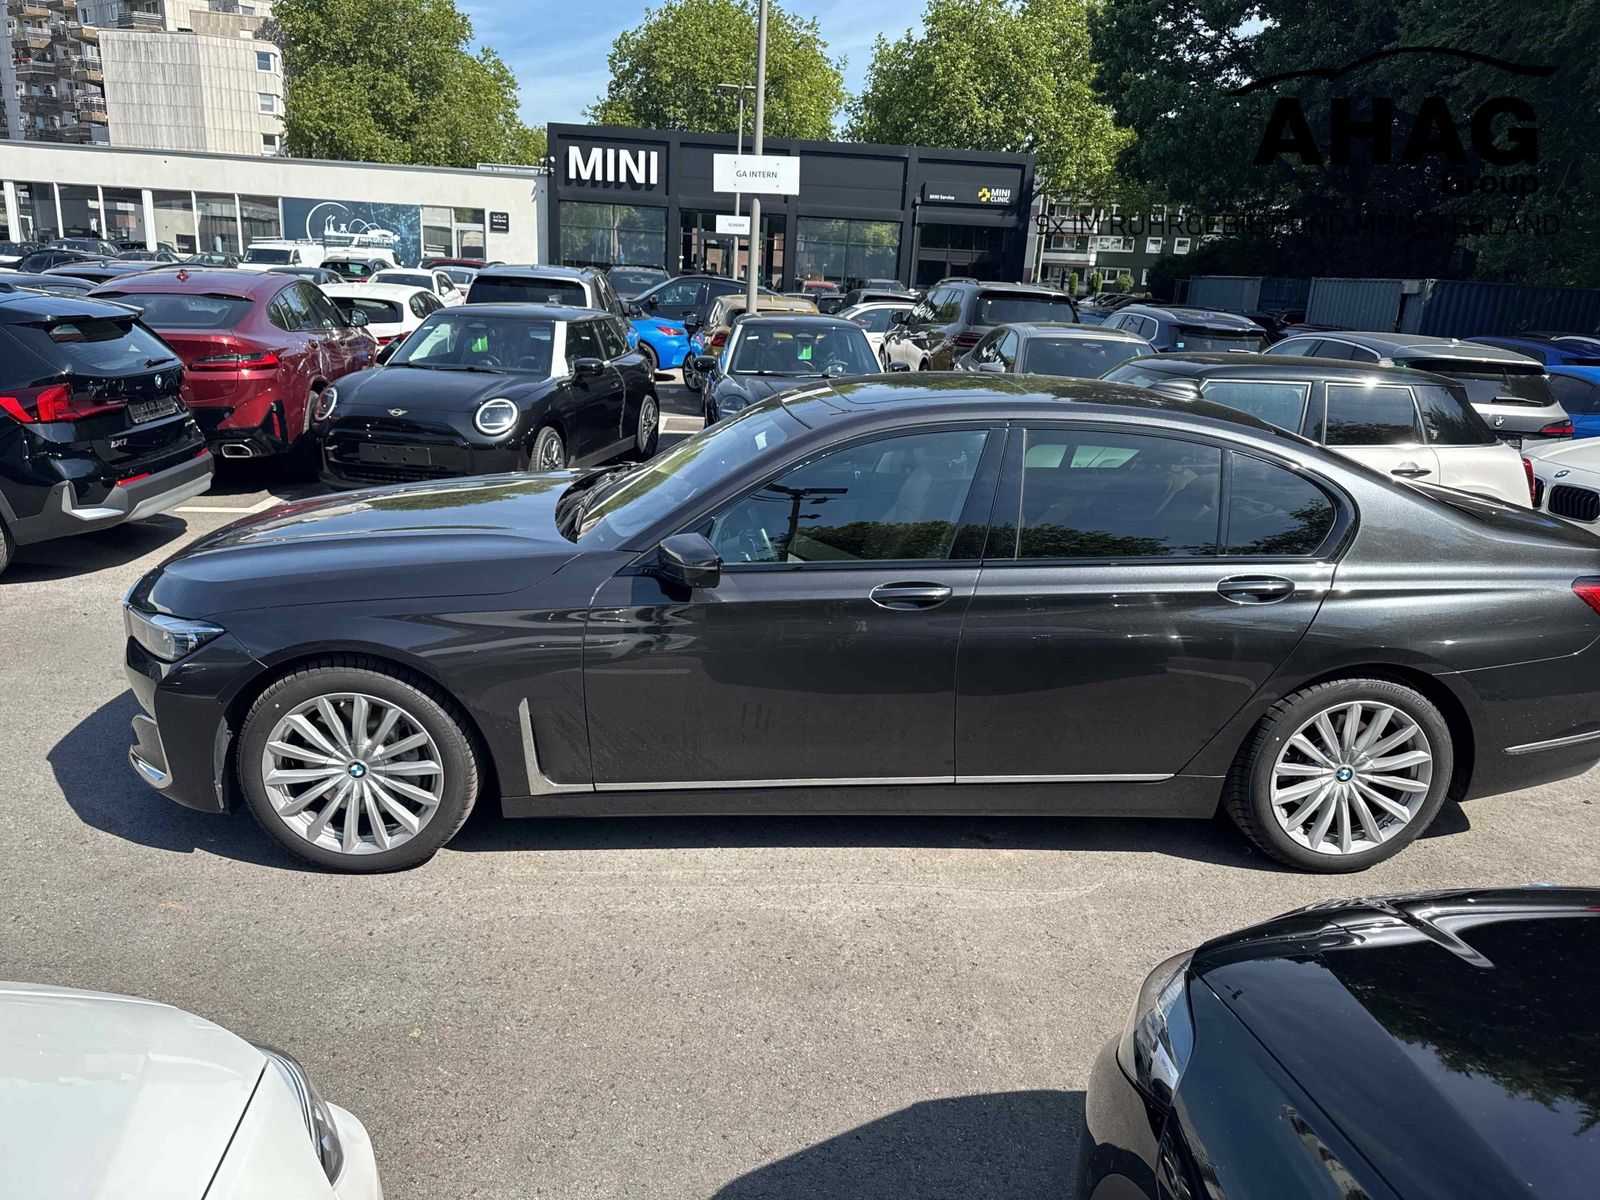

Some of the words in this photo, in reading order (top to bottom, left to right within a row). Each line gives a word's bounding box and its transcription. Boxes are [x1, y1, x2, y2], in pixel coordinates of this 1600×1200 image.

[568, 145, 658, 184] MINI
[736, 170, 748, 178] GA
[749, 170, 778, 179] INTERN
[990, 188, 1011, 197] MINI
